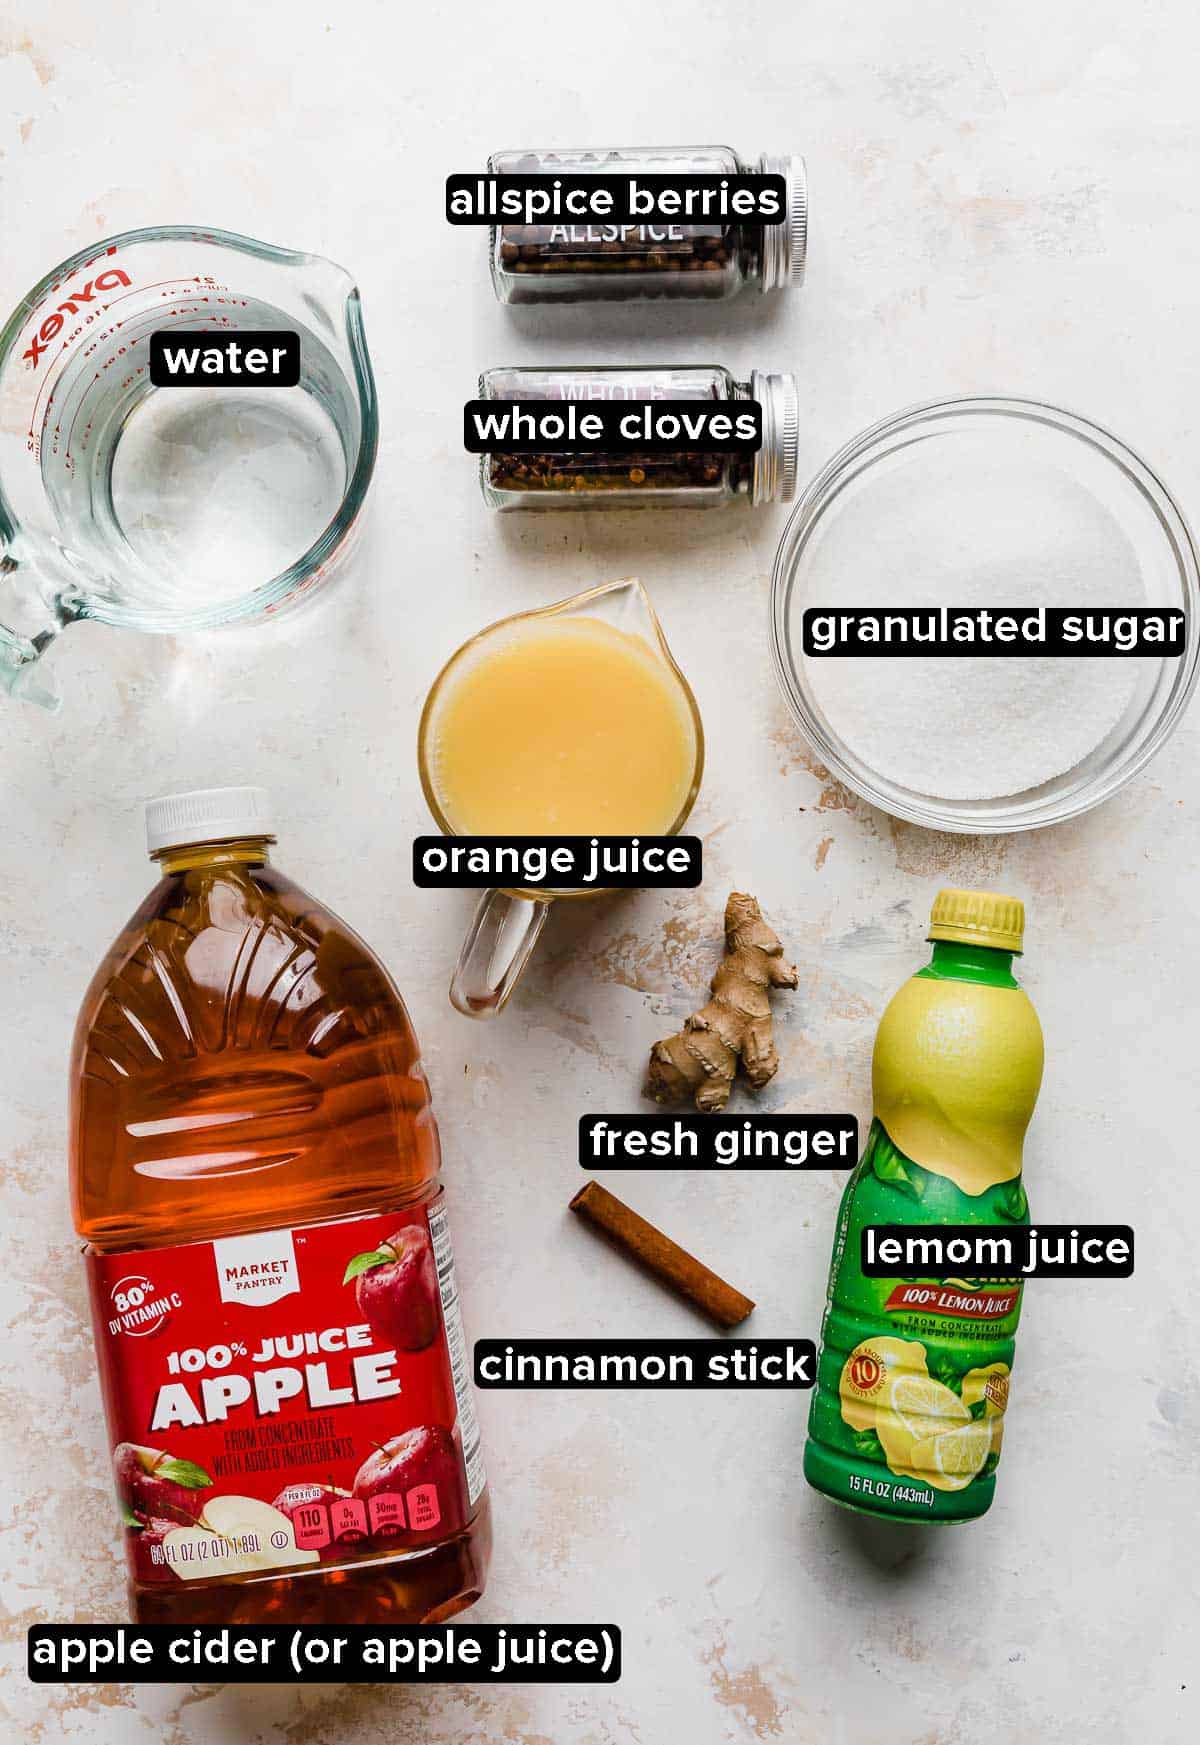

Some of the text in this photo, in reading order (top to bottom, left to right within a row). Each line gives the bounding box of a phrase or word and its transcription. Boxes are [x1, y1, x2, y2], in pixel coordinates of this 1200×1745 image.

[225, 1260, 289, 1282] MARKET
[235, 1276, 283, 1291] PANTRY
[114, 1280, 155, 1312] 80%
[902, 1288, 938, 1304] 100%
[937, 1292, 984, 1312] LEMON
[121, 1297, 172, 1329] VITAMIN
[170, 1292, 182, 1308] C
[908, 1315, 936, 1327] FROM
[166, 1323, 374, 1375] 100% JUICE
[855, 1360, 878, 1384] 10
[151, 1349, 402, 1431] APPLE
[848, 1474, 934, 1507] 15 FL OZ (443mL)
[300, 1509, 321, 1528] 110
[165, 1545, 179, 1563] FL
[180, 1542, 195, 1561] OZ
[197, 1540, 209, 1561] (2
[211, 1538, 230, 1558] QT)
